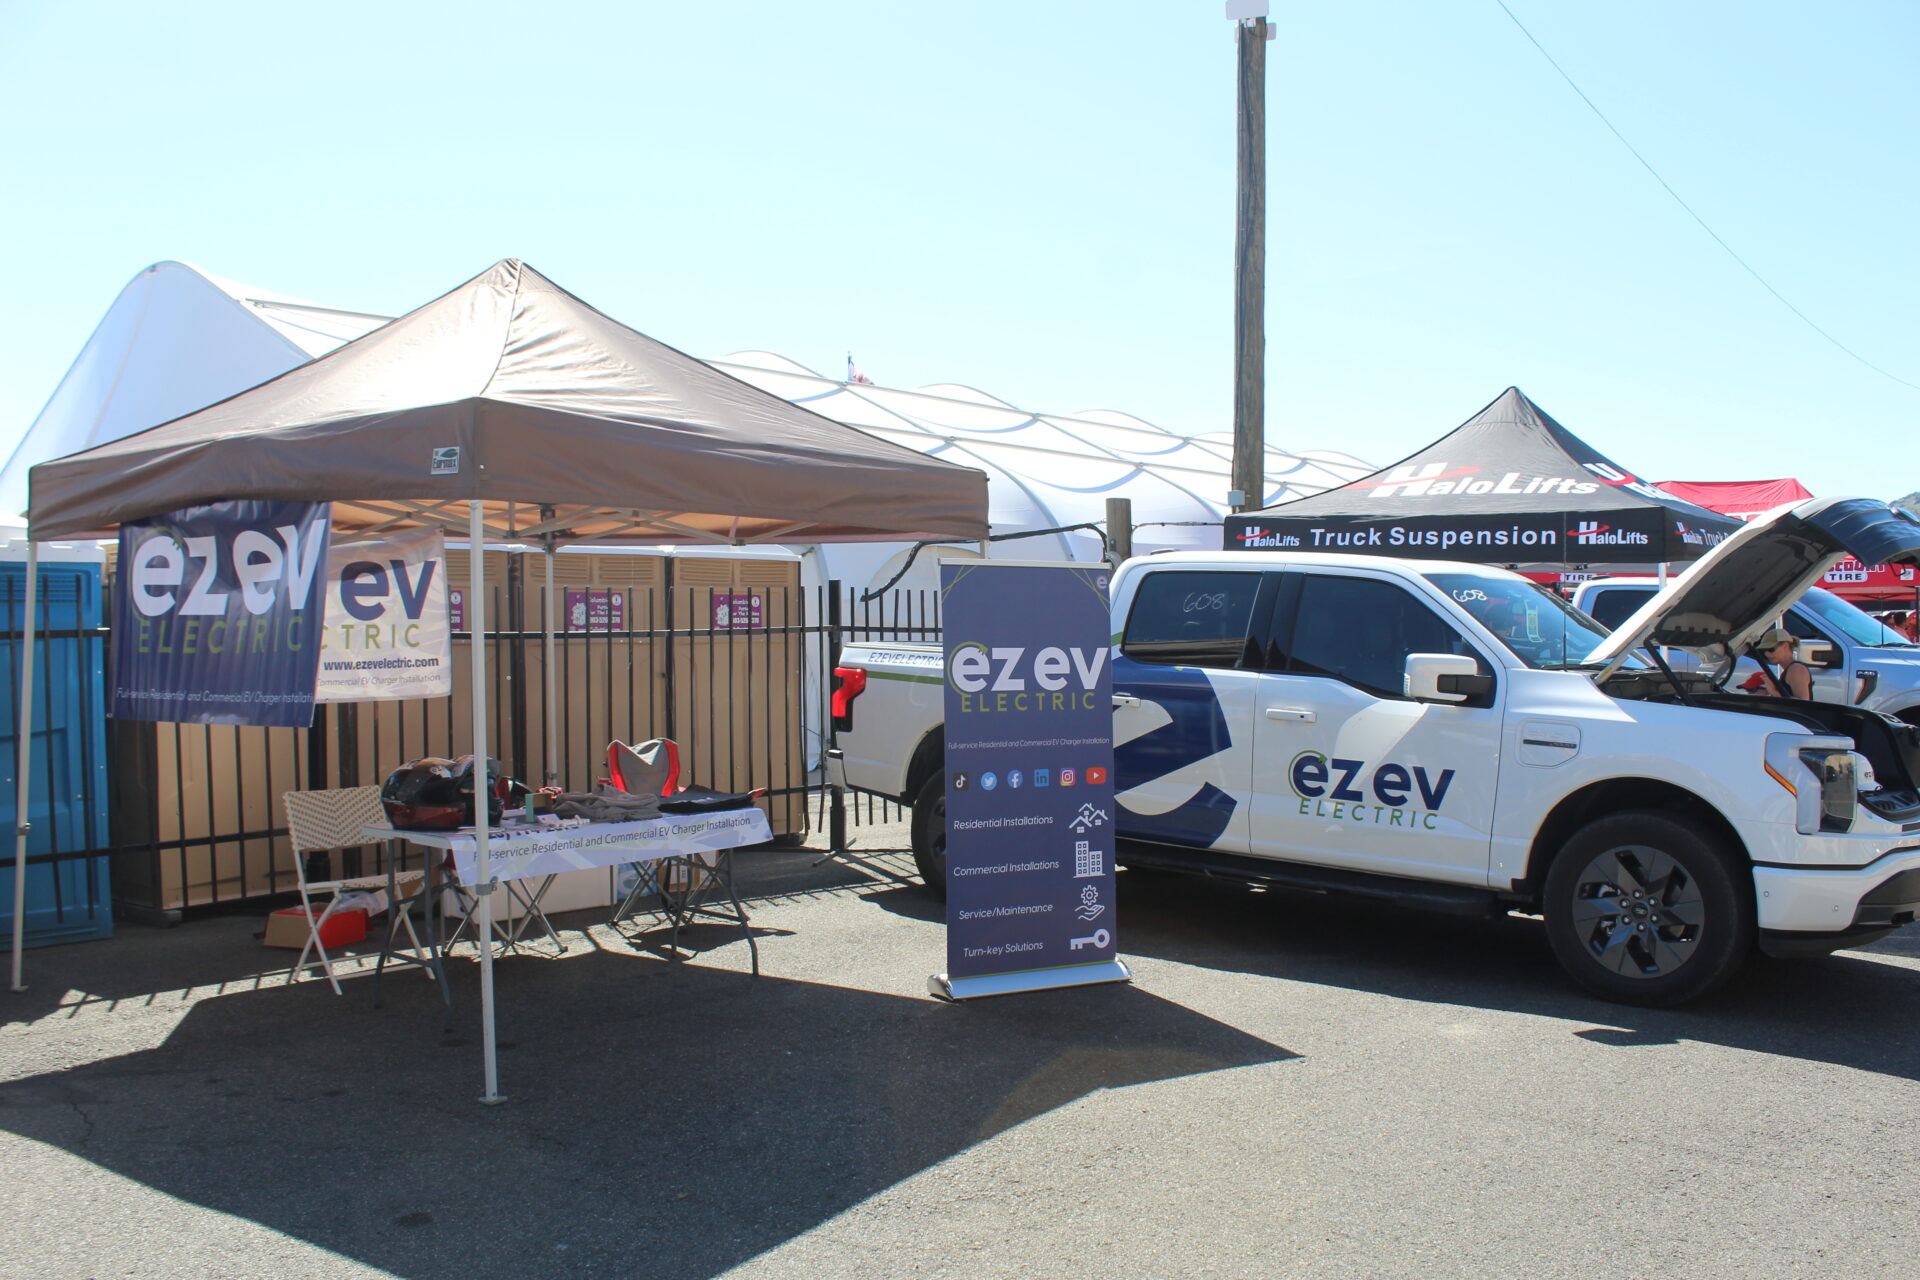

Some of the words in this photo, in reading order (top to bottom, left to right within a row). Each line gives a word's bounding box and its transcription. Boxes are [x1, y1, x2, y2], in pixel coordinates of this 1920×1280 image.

[1367, 462, 1600, 498] HaloLifts
[1244, 526, 1300, 547] HaloLifts
[1309, 528, 1381, 546] Truck
[1389, 526, 1556, 549] Suspension
[1578, 521, 1648, 545] HaloLifts
[1829, 573, 1863, 581] TIRE
[340, 559, 438, 622] ev
[1452, 589, 1488, 603] 608
[1183, 592, 1225, 613] 608
[138, 617, 303, 654] ELECTRIC
[321, 623, 421, 650] CTRIC
[323, 657, 439, 671] www.ezevelectric.com
[951, 646, 1026, 693] ez
[1033, 646, 1109, 691] ev
[318, 678, 360, 687] ommercial
[187, 690, 202, 702] and
[203, 690, 242, 702] Commercial
[243, 691, 254, 702] EV
[255, 691, 281, 706] Charger
[961, 692, 1096, 713] ELECTRIC
[948, 742, 978, 750] Full-service
[978, 740, 1008, 749] Residential
[1008, 740, 1019, 748] and
[1020, 739, 1052, 747] Commercial
[1052, 738, 1060, 746] EV
[1060, 738, 1082, 747] Charger
[1082, 737, 1110, 745] Installation
[1291, 754, 1365, 802] ez
[1372, 763, 1456, 810] ev
[953, 818, 1002, 830] Residential
[1003, 815, 1054, 827] Installations
[1299, 799, 1439, 830] ELECTRIC
[473, 846, 529, 862] Fl-service
[532, 837, 584, 854] Residential
[585, 834, 603, 847] and
[605, 828, 657, 844] Commercial
[659, 826, 671, 837] EV
[672, 822, 705, 836] Charger
[706, 816, 751, 831] Installation
[953, 864, 1008, 877] Commercial
[1009, 860, 1060, 873] Installations
[959, 903, 1053, 920] Service/Maintenance
[963, 944, 1004, 958] Turn-key
[1005, 941, 1044, 954] Solutions
